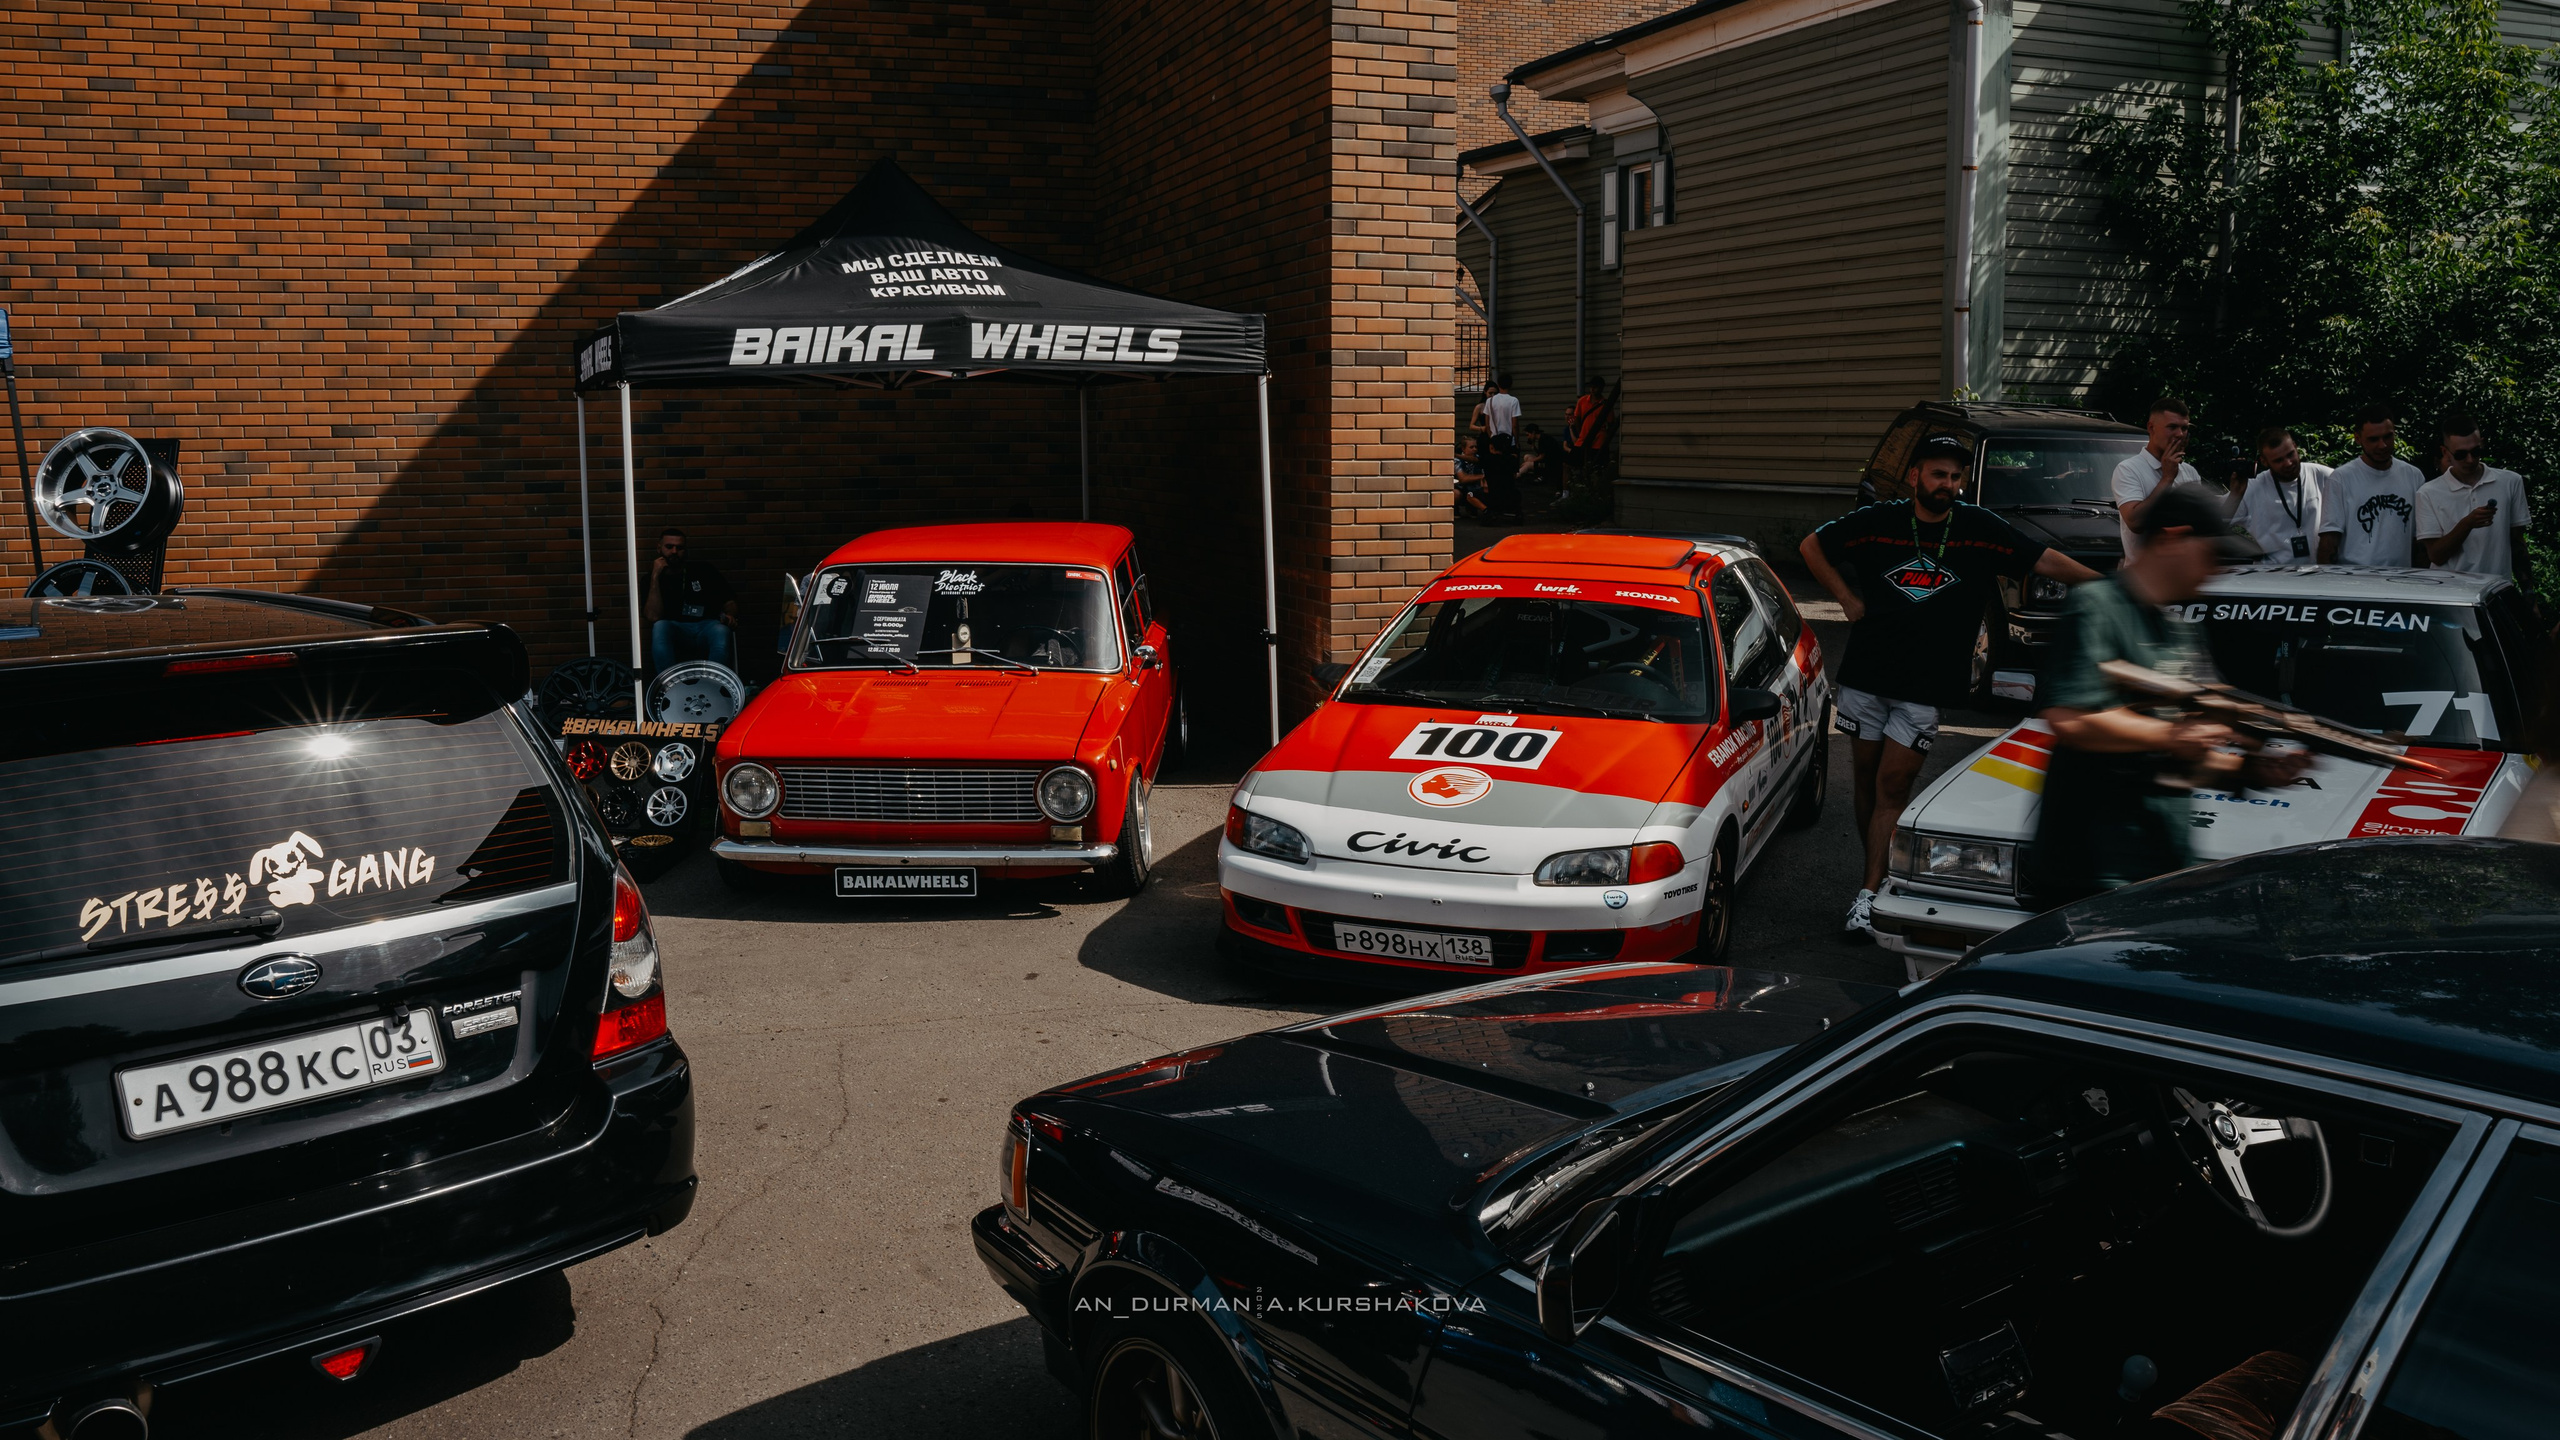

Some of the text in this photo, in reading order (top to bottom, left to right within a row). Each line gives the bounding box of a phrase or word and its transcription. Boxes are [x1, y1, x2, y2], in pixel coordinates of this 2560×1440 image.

[841, 251, 1003, 274] МЫ СДЕЛАЕМ
[870, 268, 989, 285] ВАШ АВТО
[870, 284, 1006, 298] КРАСИВЫМ
[729, 322, 1182, 365] BAIKAL WHEELS
[934, 569, 978, 585] Black
[870, 583, 899, 591] 12 ИЮЛЯ
[1444, 584, 1503, 592] HONDA
[1615, 590, 1680, 604] HONDA
[2212, 603, 2319, 623] SIMPLE
[2326, 606, 2430, 633] CLEAN
[2381, 690, 2501, 742] 71
[562, 717, 719, 742] #BAIKALWHEELS
[1415, 727, 1548, 762] 100
[1707, 734, 1739, 769] EBANOK
[1732, 720, 1757, 748] RACING
[1347, 831, 1490, 863] Civic
[327, 847, 435, 897] GANG
[843, 875, 969, 889] BAIKALWHEELS
[1664, 884, 1698, 899] TOYO TIRES
[1445, 938, 1483, 955] 138
[1455, 954, 1475, 962] RUS
[442, 989, 522, 1018] FORESTER
[460, 1016, 514, 1035] SPORTS
[463, 1010, 508, 1028] CROSS
[369, 1025, 417, 1060] 03
[373, 1057, 407, 1076] RUS
